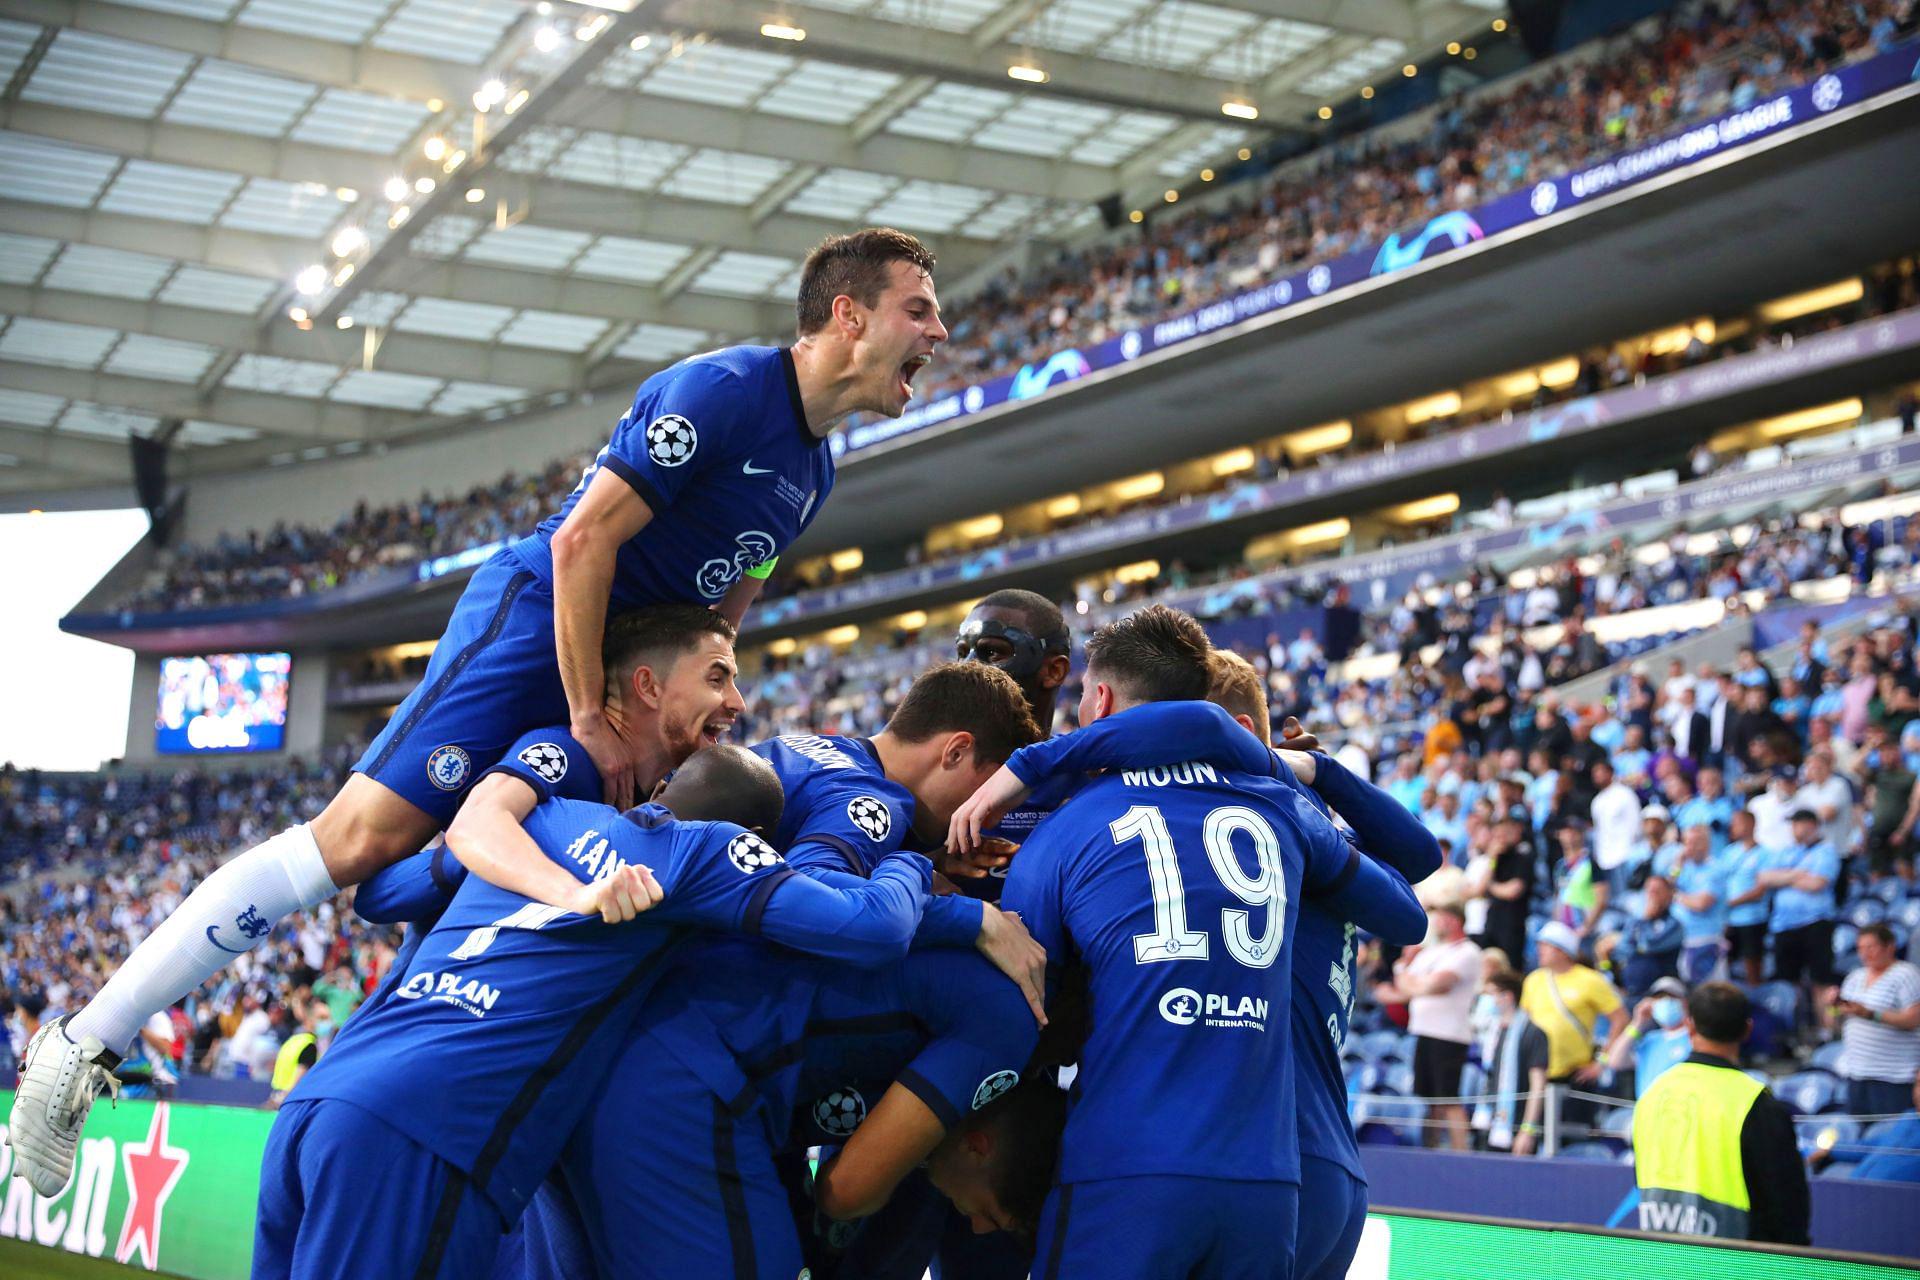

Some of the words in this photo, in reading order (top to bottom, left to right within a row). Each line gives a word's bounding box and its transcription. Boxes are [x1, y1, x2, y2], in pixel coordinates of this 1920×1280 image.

[1571, 162, 1617, 197] UEFA
[1719, 95, 1793, 143] LEAGUE
[1121, 761, 1230, 787] MOUN
[1109, 805, 1287, 969] 19
[436, 972, 501, 1010] PLAN
[1205, 993, 1268, 1021] PLAN
[1205, 1018, 1265, 1032] INTERNATIONAL
